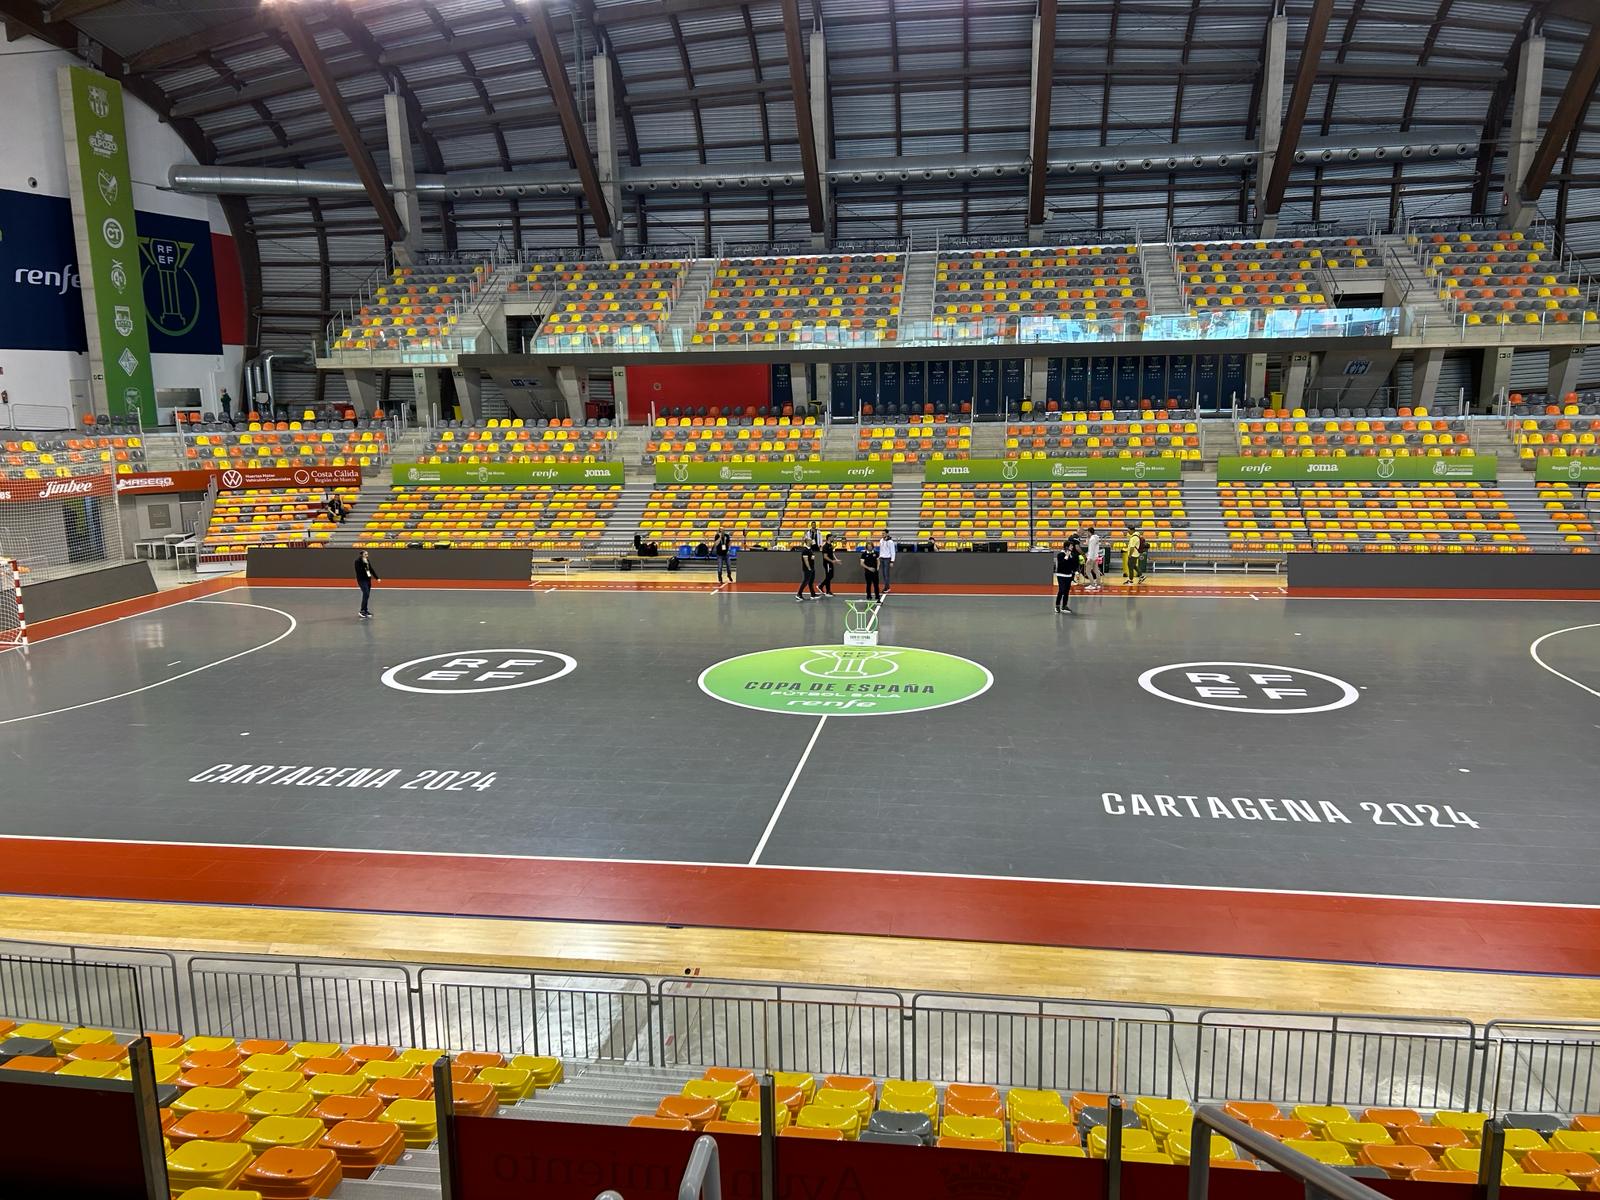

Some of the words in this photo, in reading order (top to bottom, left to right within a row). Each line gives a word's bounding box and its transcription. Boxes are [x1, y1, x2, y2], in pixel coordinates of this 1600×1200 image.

[106, 227, 120, 240] CT
[157, 244, 173, 254] RF
[158, 255, 174, 265] EF
[15, 264, 81, 295] renfe
[311, 470, 333, 478] Costa
[334, 469, 359, 478] Cálida
[532, 467, 559, 479] renfe
[847, 467, 875, 477] renfe
[1241, 463, 1272, 474] renfe
[39, 480, 93, 498] Jimbee
[441, 658, 545, 669] RF
[416, 670, 525, 682] EF
[1184, 672, 1294, 685] RF
[744, 681, 802, 691] COPA
[809, 682, 836, 692] DE
[845, 683, 936, 694] ESPAÑA
[1194, 686, 1309, 700] EF
[786, 699, 878, 709] renfe
[188, 763, 402, 788] CARTAGENA
[399, 769, 498, 792] 2024
[1101, 791, 1353, 824] CARTAGENA
[1360, 800, 1482, 830] 2024
